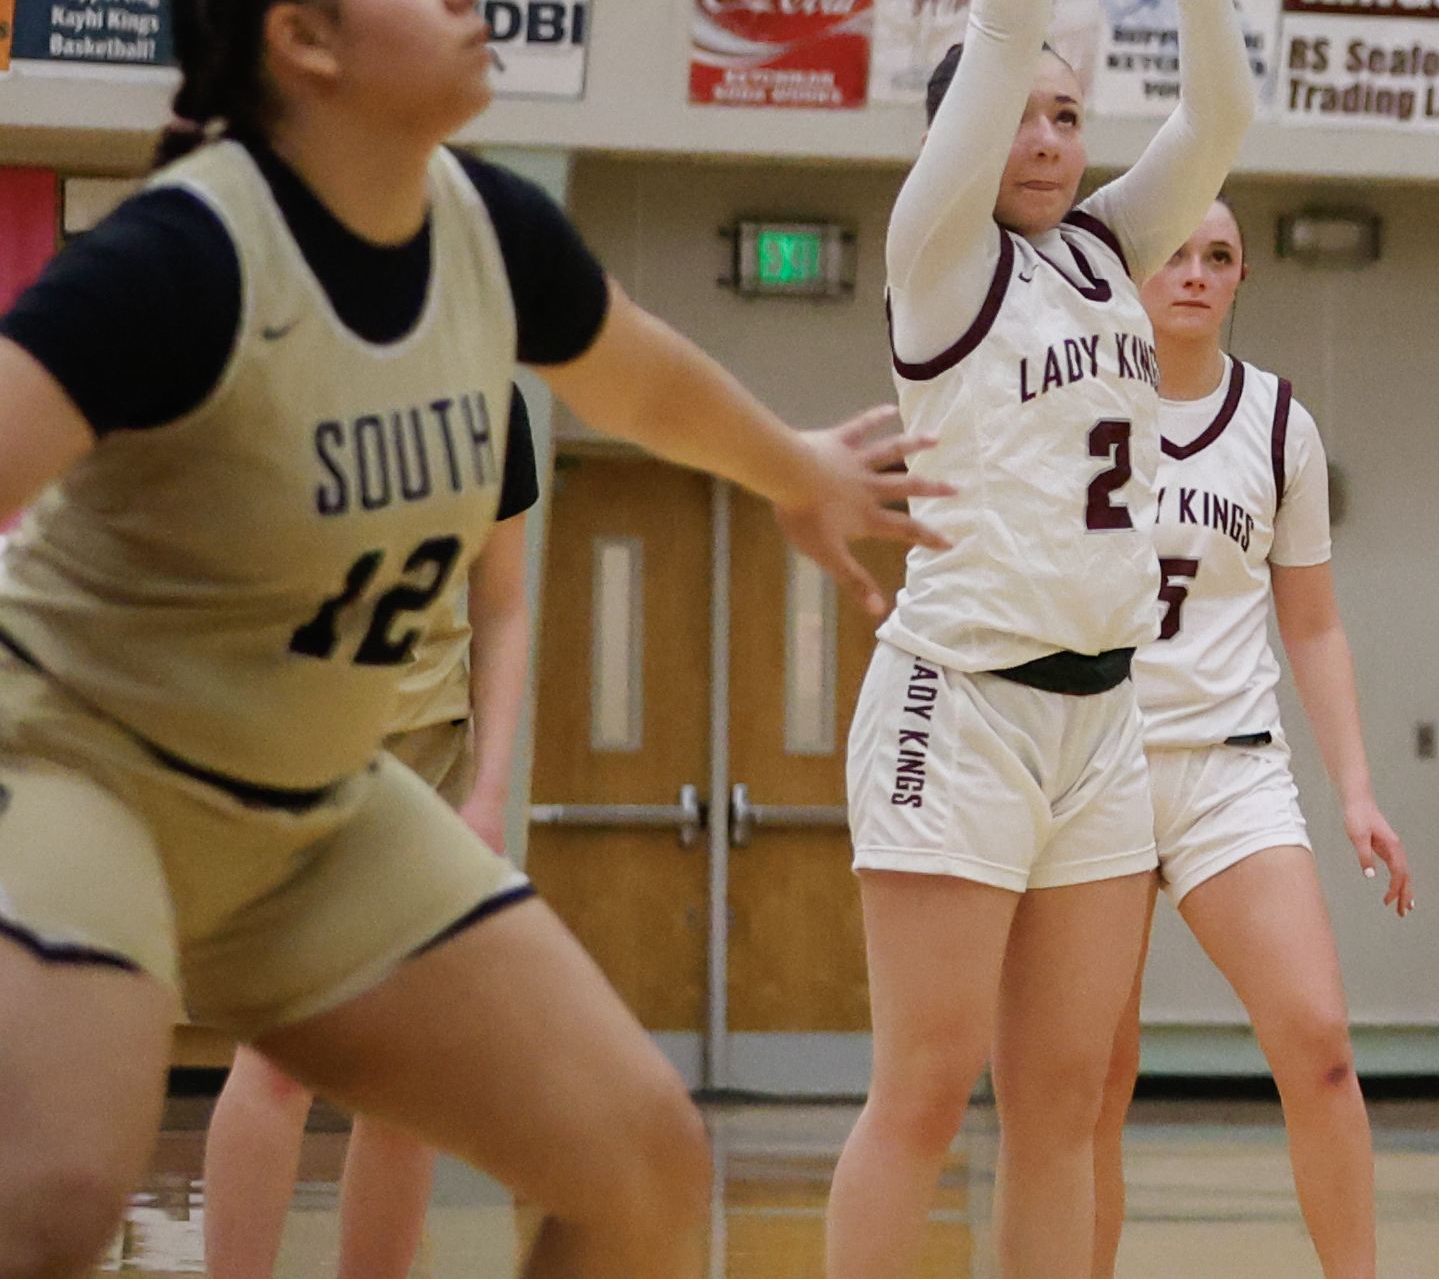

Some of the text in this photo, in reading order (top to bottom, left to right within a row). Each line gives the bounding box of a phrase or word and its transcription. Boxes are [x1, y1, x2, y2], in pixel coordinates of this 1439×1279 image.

[1289, 78, 1416, 121] Trading
[1021, 334, 1099, 403] LADY
[315, 391, 499, 516] SOUTH
[1087, 418, 1135, 532] 2
[1179, 487, 1254, 553] KINGS
[288, 534, 464, 667] 12
[891, 663, 938, 809] ADY KINGS
